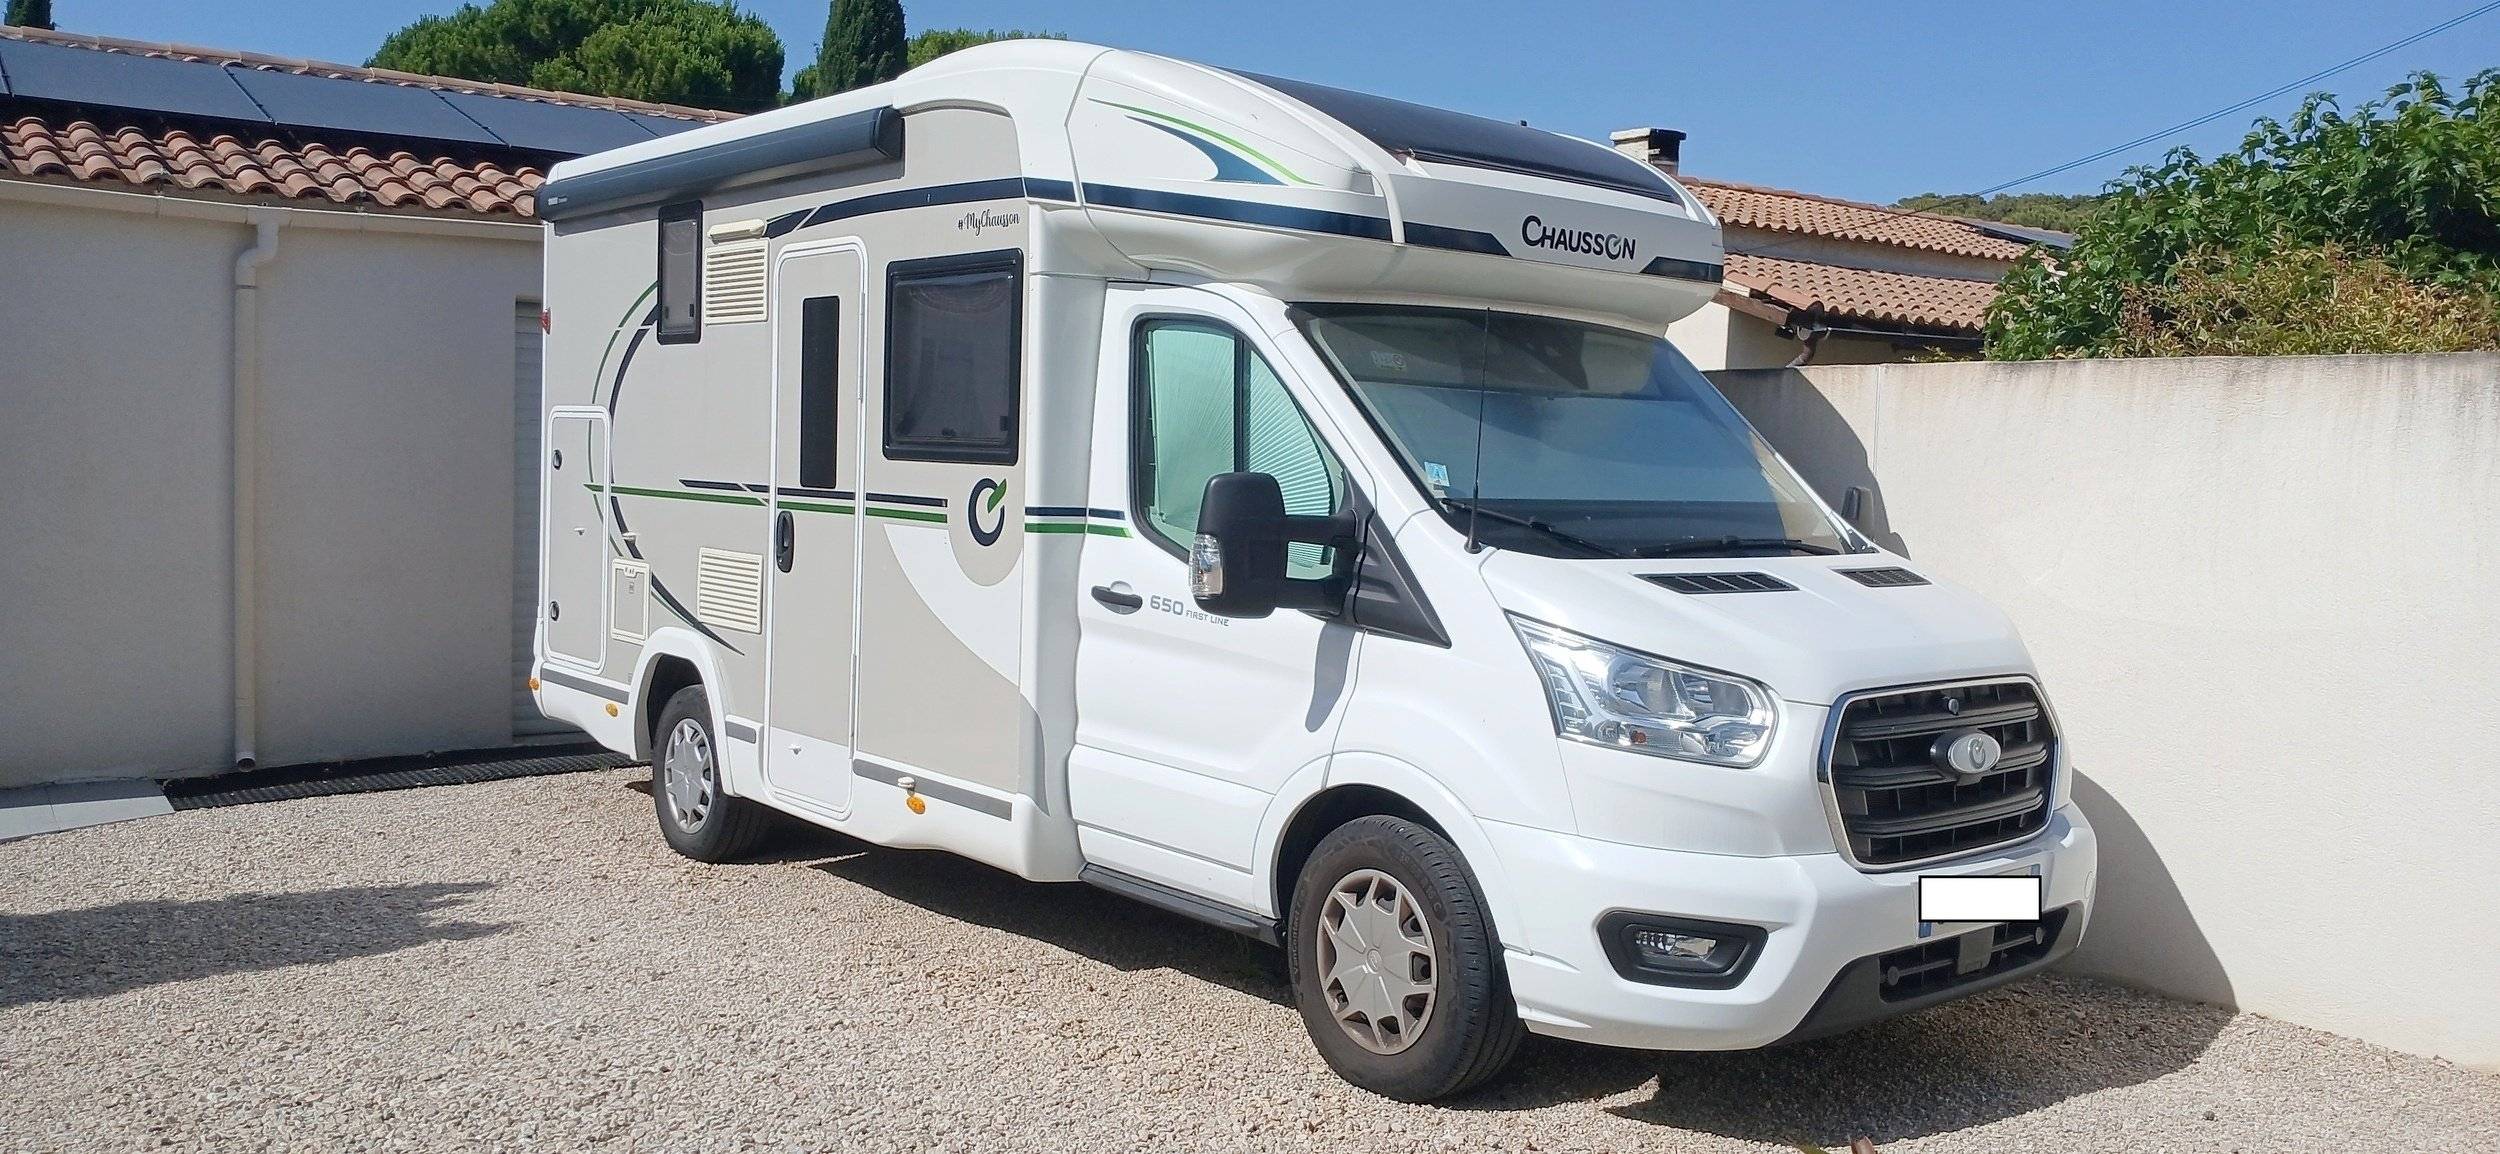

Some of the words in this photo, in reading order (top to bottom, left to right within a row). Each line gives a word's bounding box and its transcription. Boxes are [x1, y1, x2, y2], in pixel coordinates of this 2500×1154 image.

[957, 208, 1020, 236] #MyChausson
[1522, 215, 1636, 260] CHAUSSON
[1150, 594, 1184, 615] 650
[1186, 610, 1209, 621] FIRST
[1210, 616, 1229, 627] LINE
